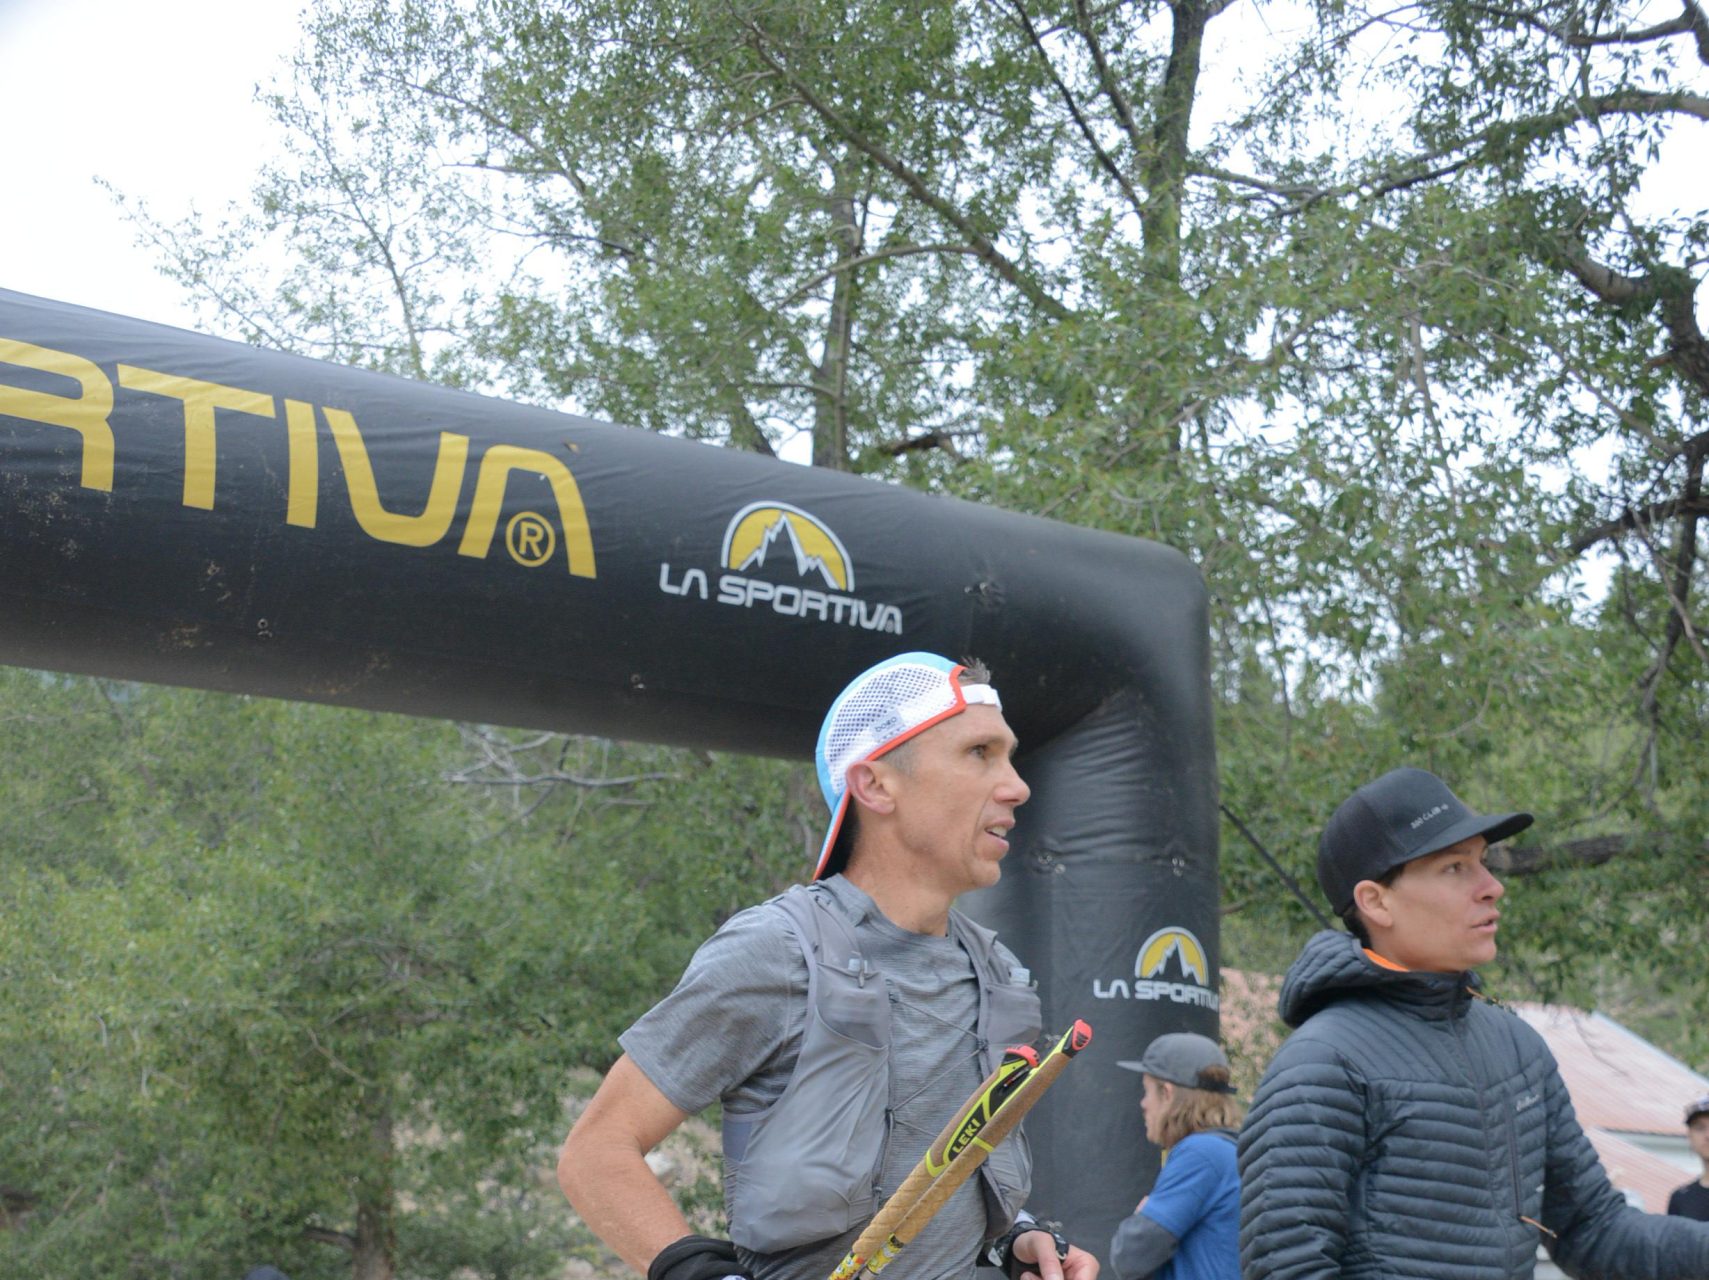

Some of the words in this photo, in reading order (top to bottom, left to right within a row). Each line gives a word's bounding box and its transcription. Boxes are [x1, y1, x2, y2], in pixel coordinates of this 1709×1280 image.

[659, 562, 709, 600] LA
[717, 574, 903, 635] SPORTIVA
[1093, 978, 1130, 999] LA
[1134, 979, 1219, 1012] SPORTIV
[952, 1117, 982, 1155] LEKI
